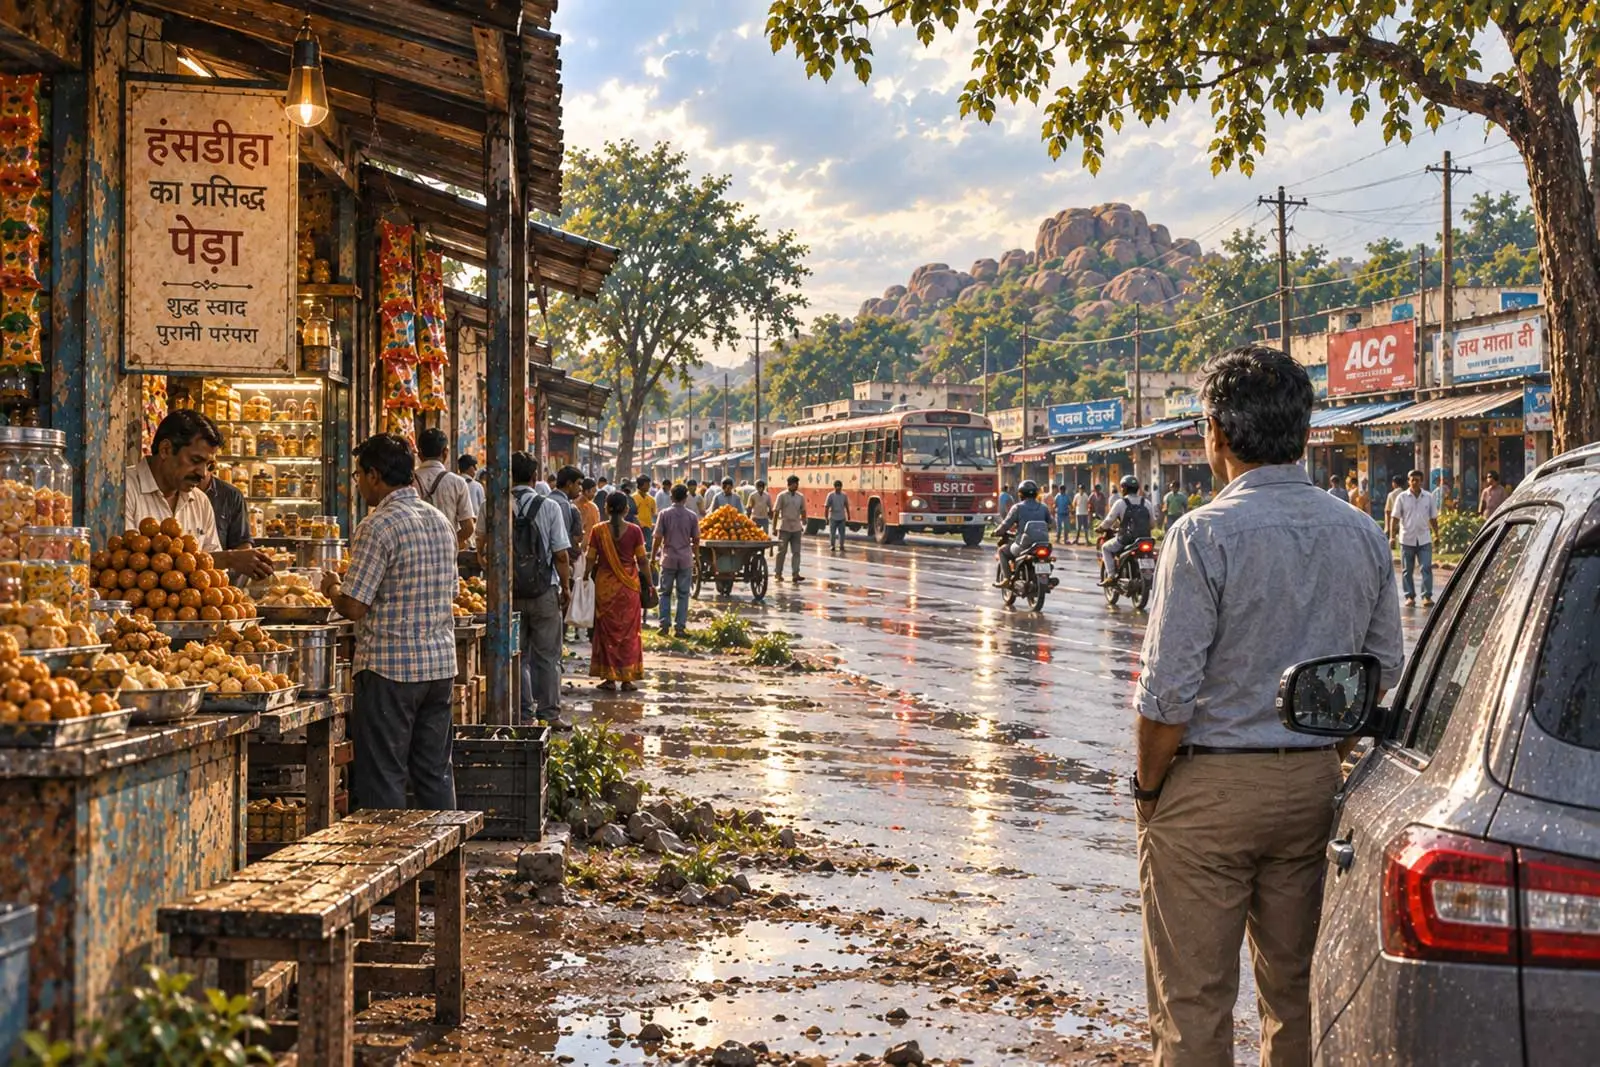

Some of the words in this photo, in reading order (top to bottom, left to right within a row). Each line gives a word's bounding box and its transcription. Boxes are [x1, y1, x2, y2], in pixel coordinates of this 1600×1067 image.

[145, 118, 274, 170] हंसडीहा
[149, 180, 180, 205] का
[191, 175, 267, 211] प्रसिद्ध
[168, 214, 243, 274] पेड़ा
[167, 298, 201, 319] शुद्ध
[206, 299, 248, 317] स्वाद
[157, 321, 201, 346] पुरानी
[209, 323, 259, 343] परंपरा
[1457, 338, 1479, 357] जय
[1482, 332, 1513, 352] माता
[1517, 322, 1535, 348] दी
[1344, 335, 1397, 371] ACC
[933, 482, 976, 493] BSRTC
